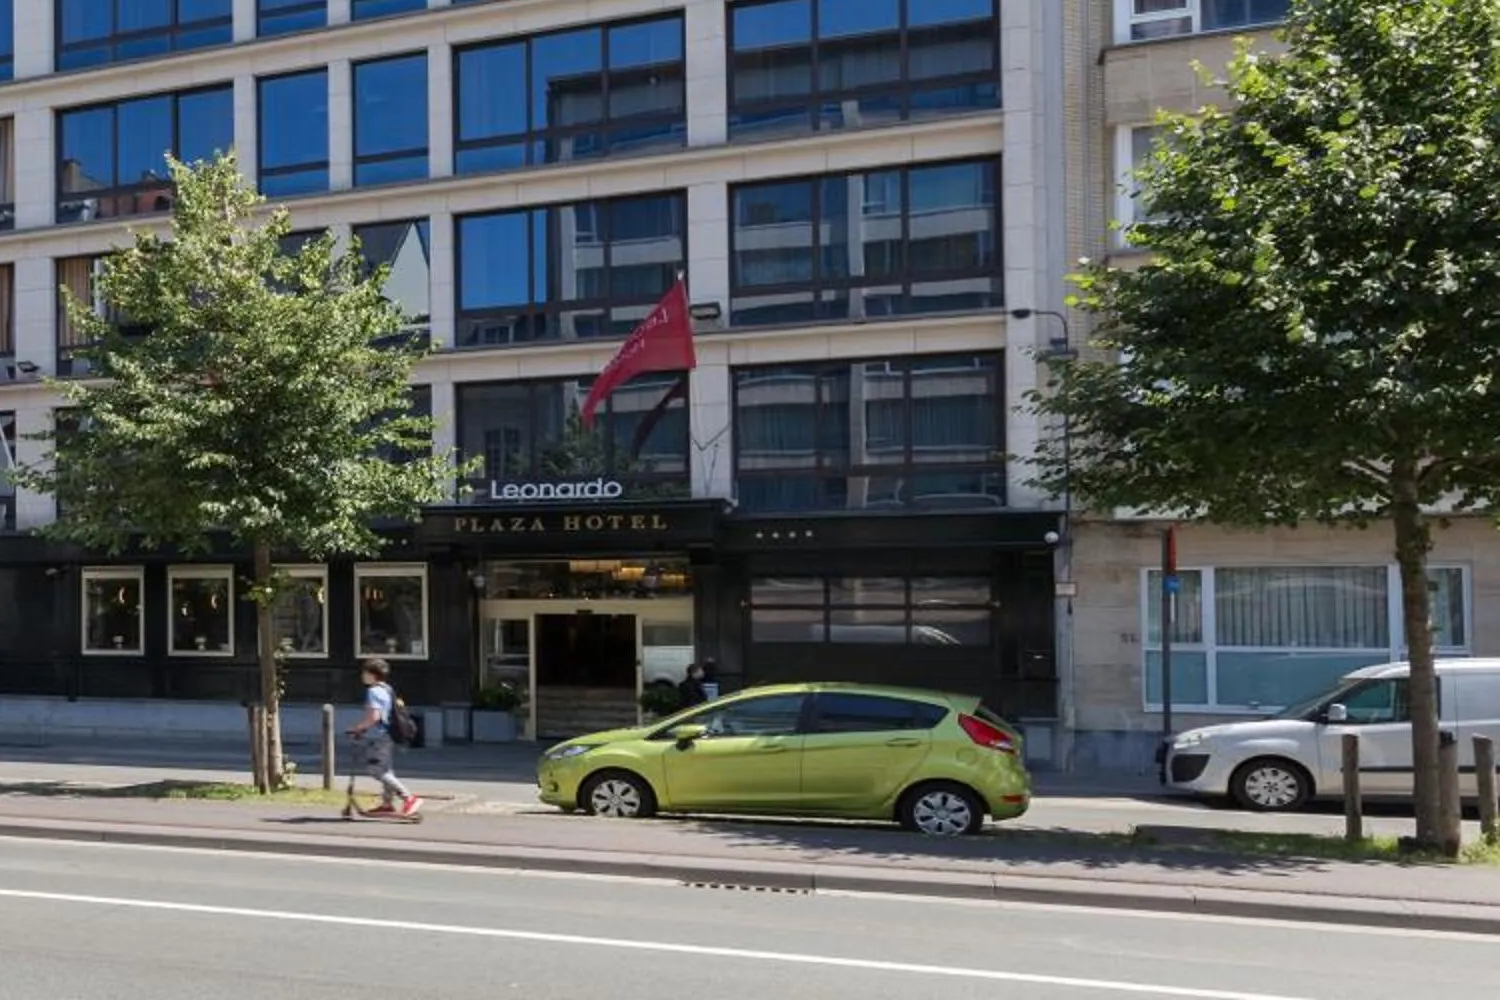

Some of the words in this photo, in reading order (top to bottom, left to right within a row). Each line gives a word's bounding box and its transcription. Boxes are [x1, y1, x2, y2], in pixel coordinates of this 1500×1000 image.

[490, 477, 623, 500] Leonardo
[454, 517, 545, 533] PLAZA
[563, 514, 668, 531] HOTEL
